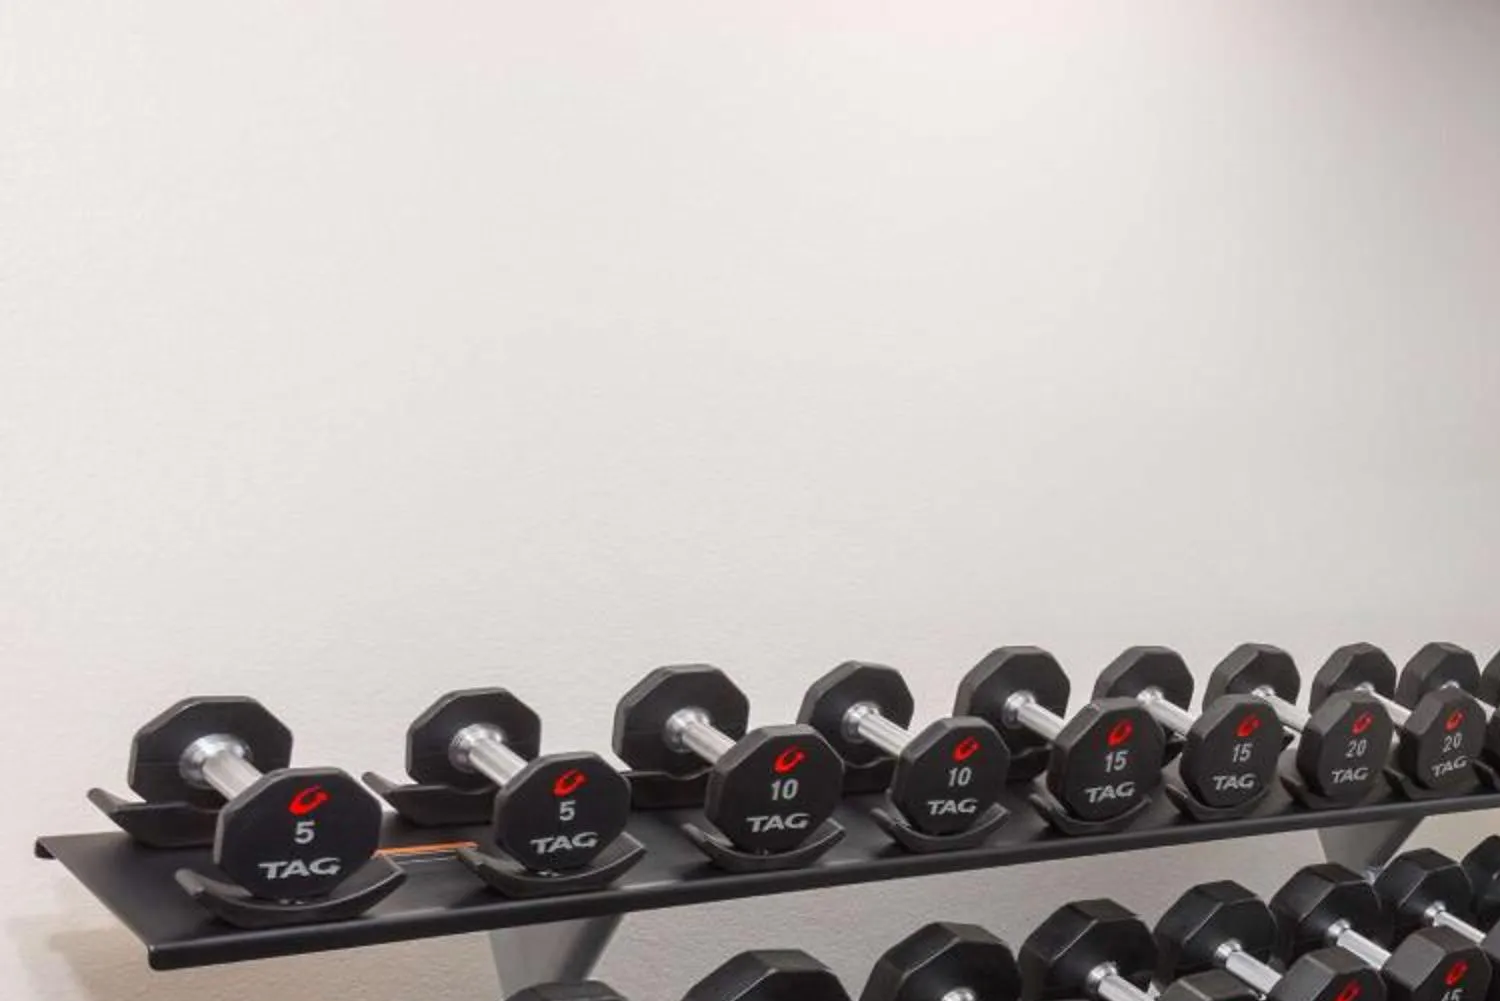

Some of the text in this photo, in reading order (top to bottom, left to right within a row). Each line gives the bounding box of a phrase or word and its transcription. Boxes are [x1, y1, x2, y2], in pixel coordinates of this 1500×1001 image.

[1232, 742, 1253, 763] 15
[1345, 738, 1367, 758] 20
[1442, 732, 1463, 752] 20
[1105, 750, 1129, 773] 15
[1431, 755, 1467, 777] TAG
[948, 766, 973, 787] 10
[1212, 773, 1255, 791] TAG
[1331, 766, 1369, 784] TAG
[771, 778, 799, 801] 10
[1084, 781, 1135, 804] TAG
[559, 799, 576, 822] 5
[927, 798, 977, 816] TAG
[294, 820, 315, 845] 5
[746, 812, 809, 833] TAG
[530, 831, 598, 855] TAG
[258, 857, 341, 880] TAG
